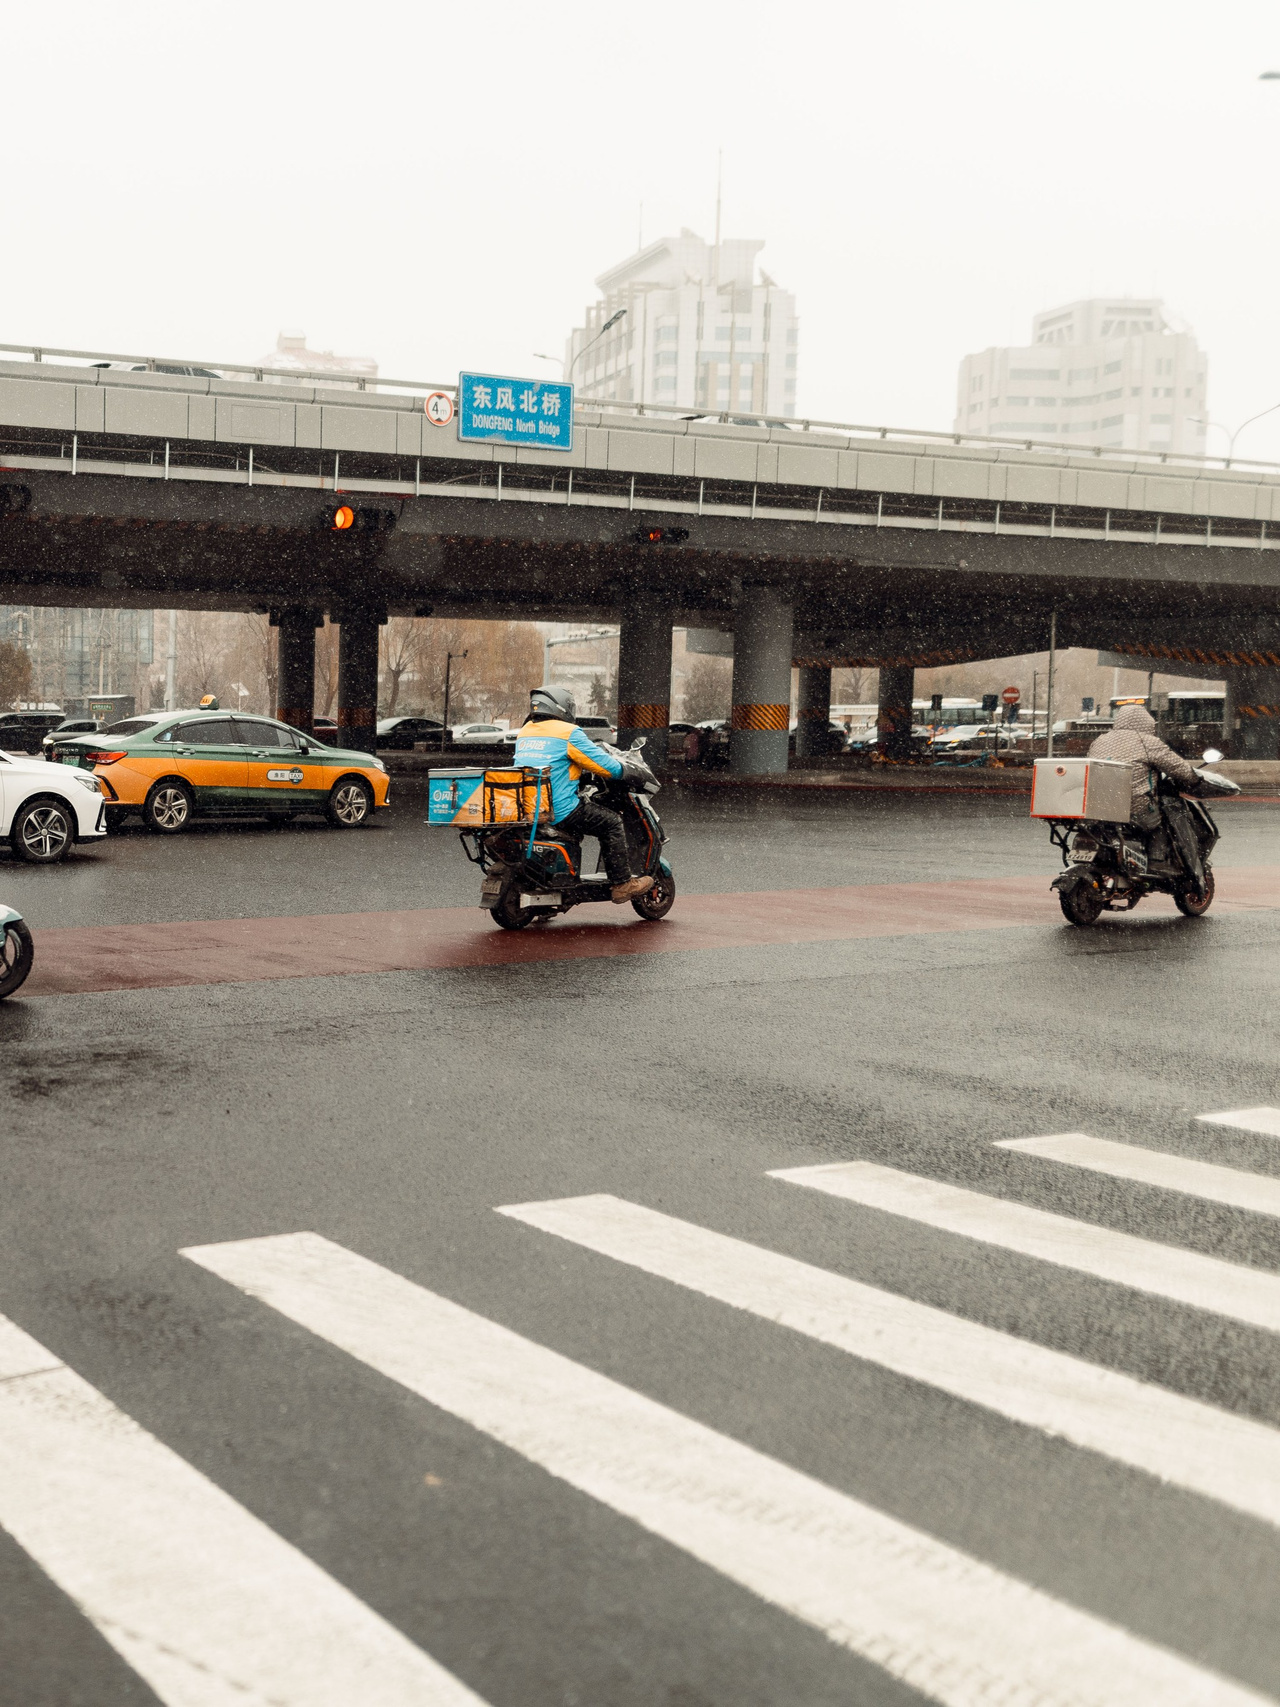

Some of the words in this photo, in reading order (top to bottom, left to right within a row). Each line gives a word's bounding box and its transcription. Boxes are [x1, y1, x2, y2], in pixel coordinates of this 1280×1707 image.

[472, 385, 561, 416] 东风北桥
[472, 414, 513, 431] DONGFENG
[516, 418, 536, 433] North
[538, 420, 560, 438] Bridge
